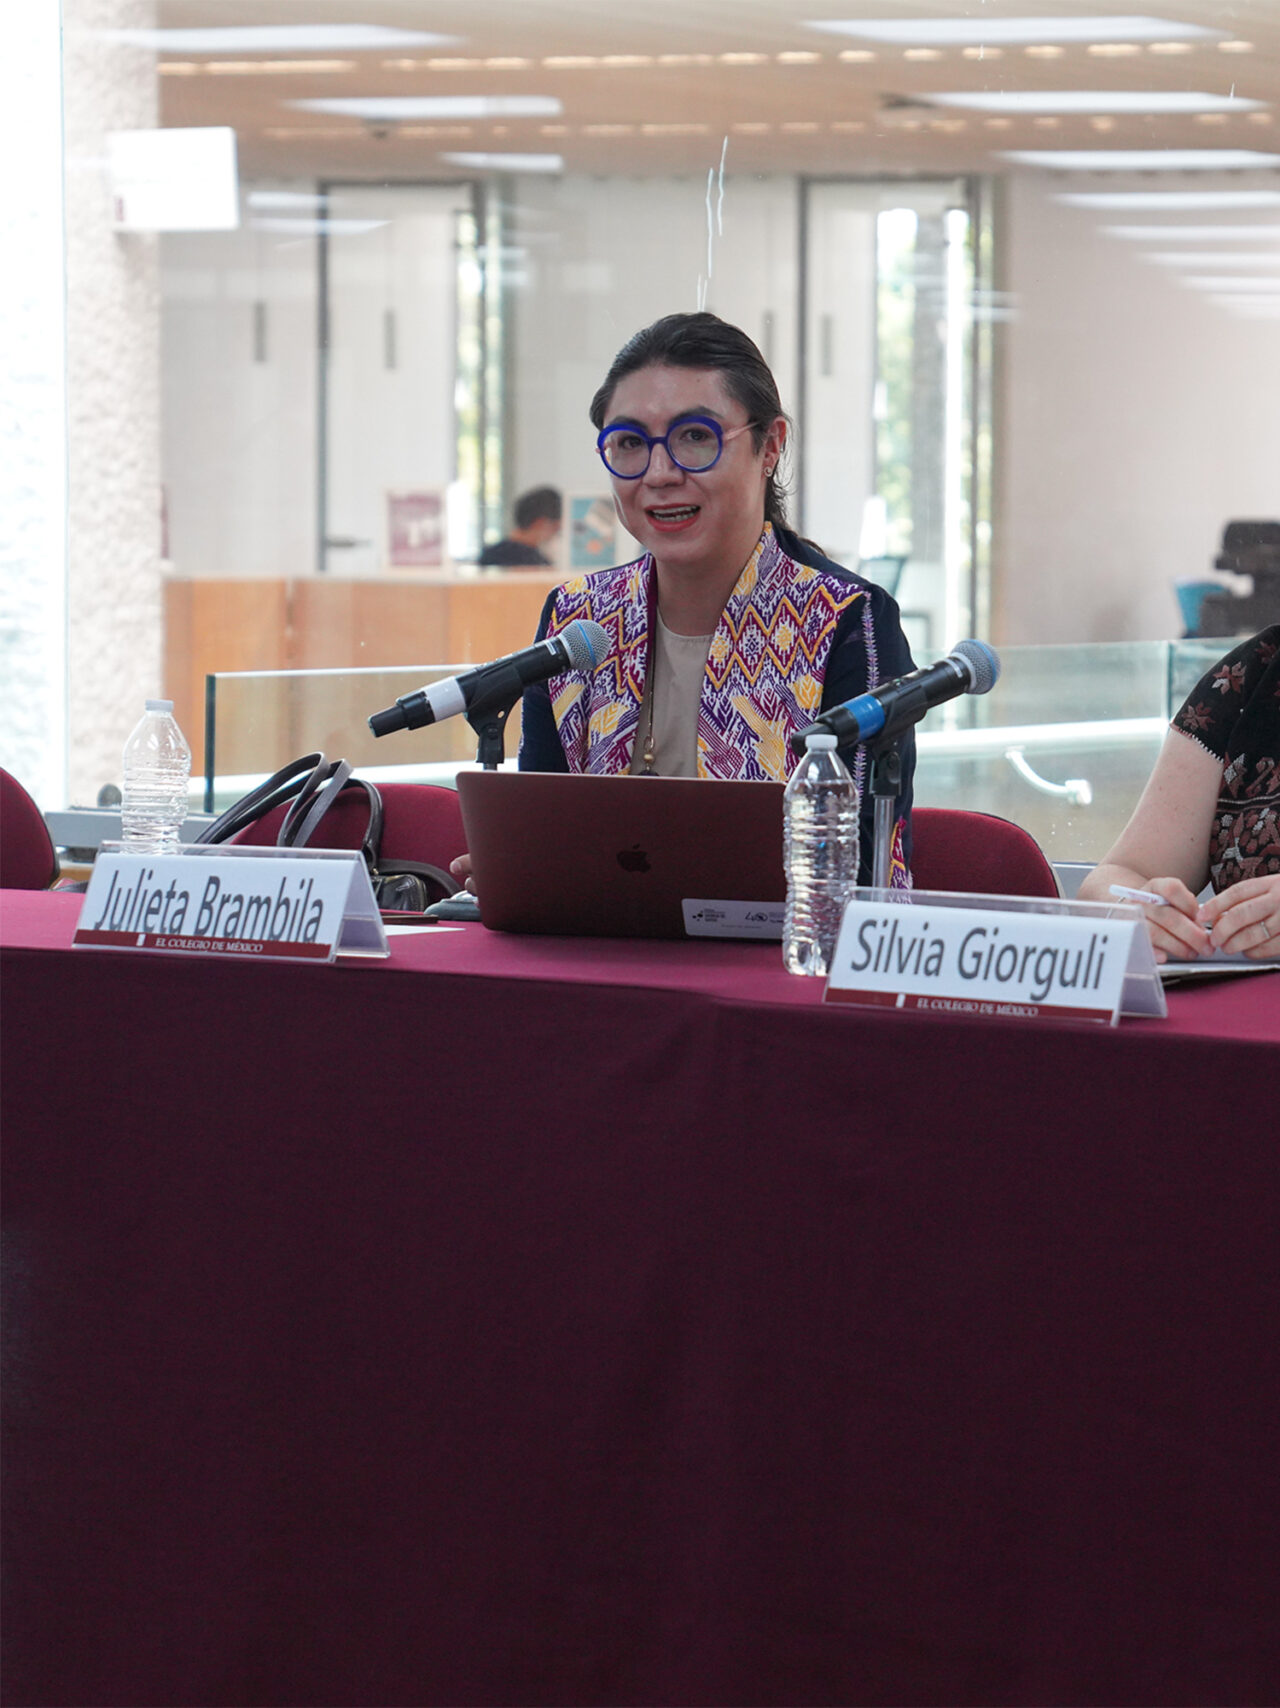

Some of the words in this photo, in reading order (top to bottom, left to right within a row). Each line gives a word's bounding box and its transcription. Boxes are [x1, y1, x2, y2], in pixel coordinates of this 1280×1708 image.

[94, 868, 190, 935] Julieta
[195, 875, 324, 943] Brambila
[155, 937, 166, 947] EL
[168, 938, 211, 950] COLEGIO
[211, 940, 225, 951] DE
[226, 940, 264, 953] MÉXICO
[850, 918, 946, 978] Silvia
[957, 926, 1109, 1002] Giorguli
[917, 998, 929, 1009] EL
[930, 999, 979, 1012] COLEGIO
[979, 1002, 994, 1015] DE
